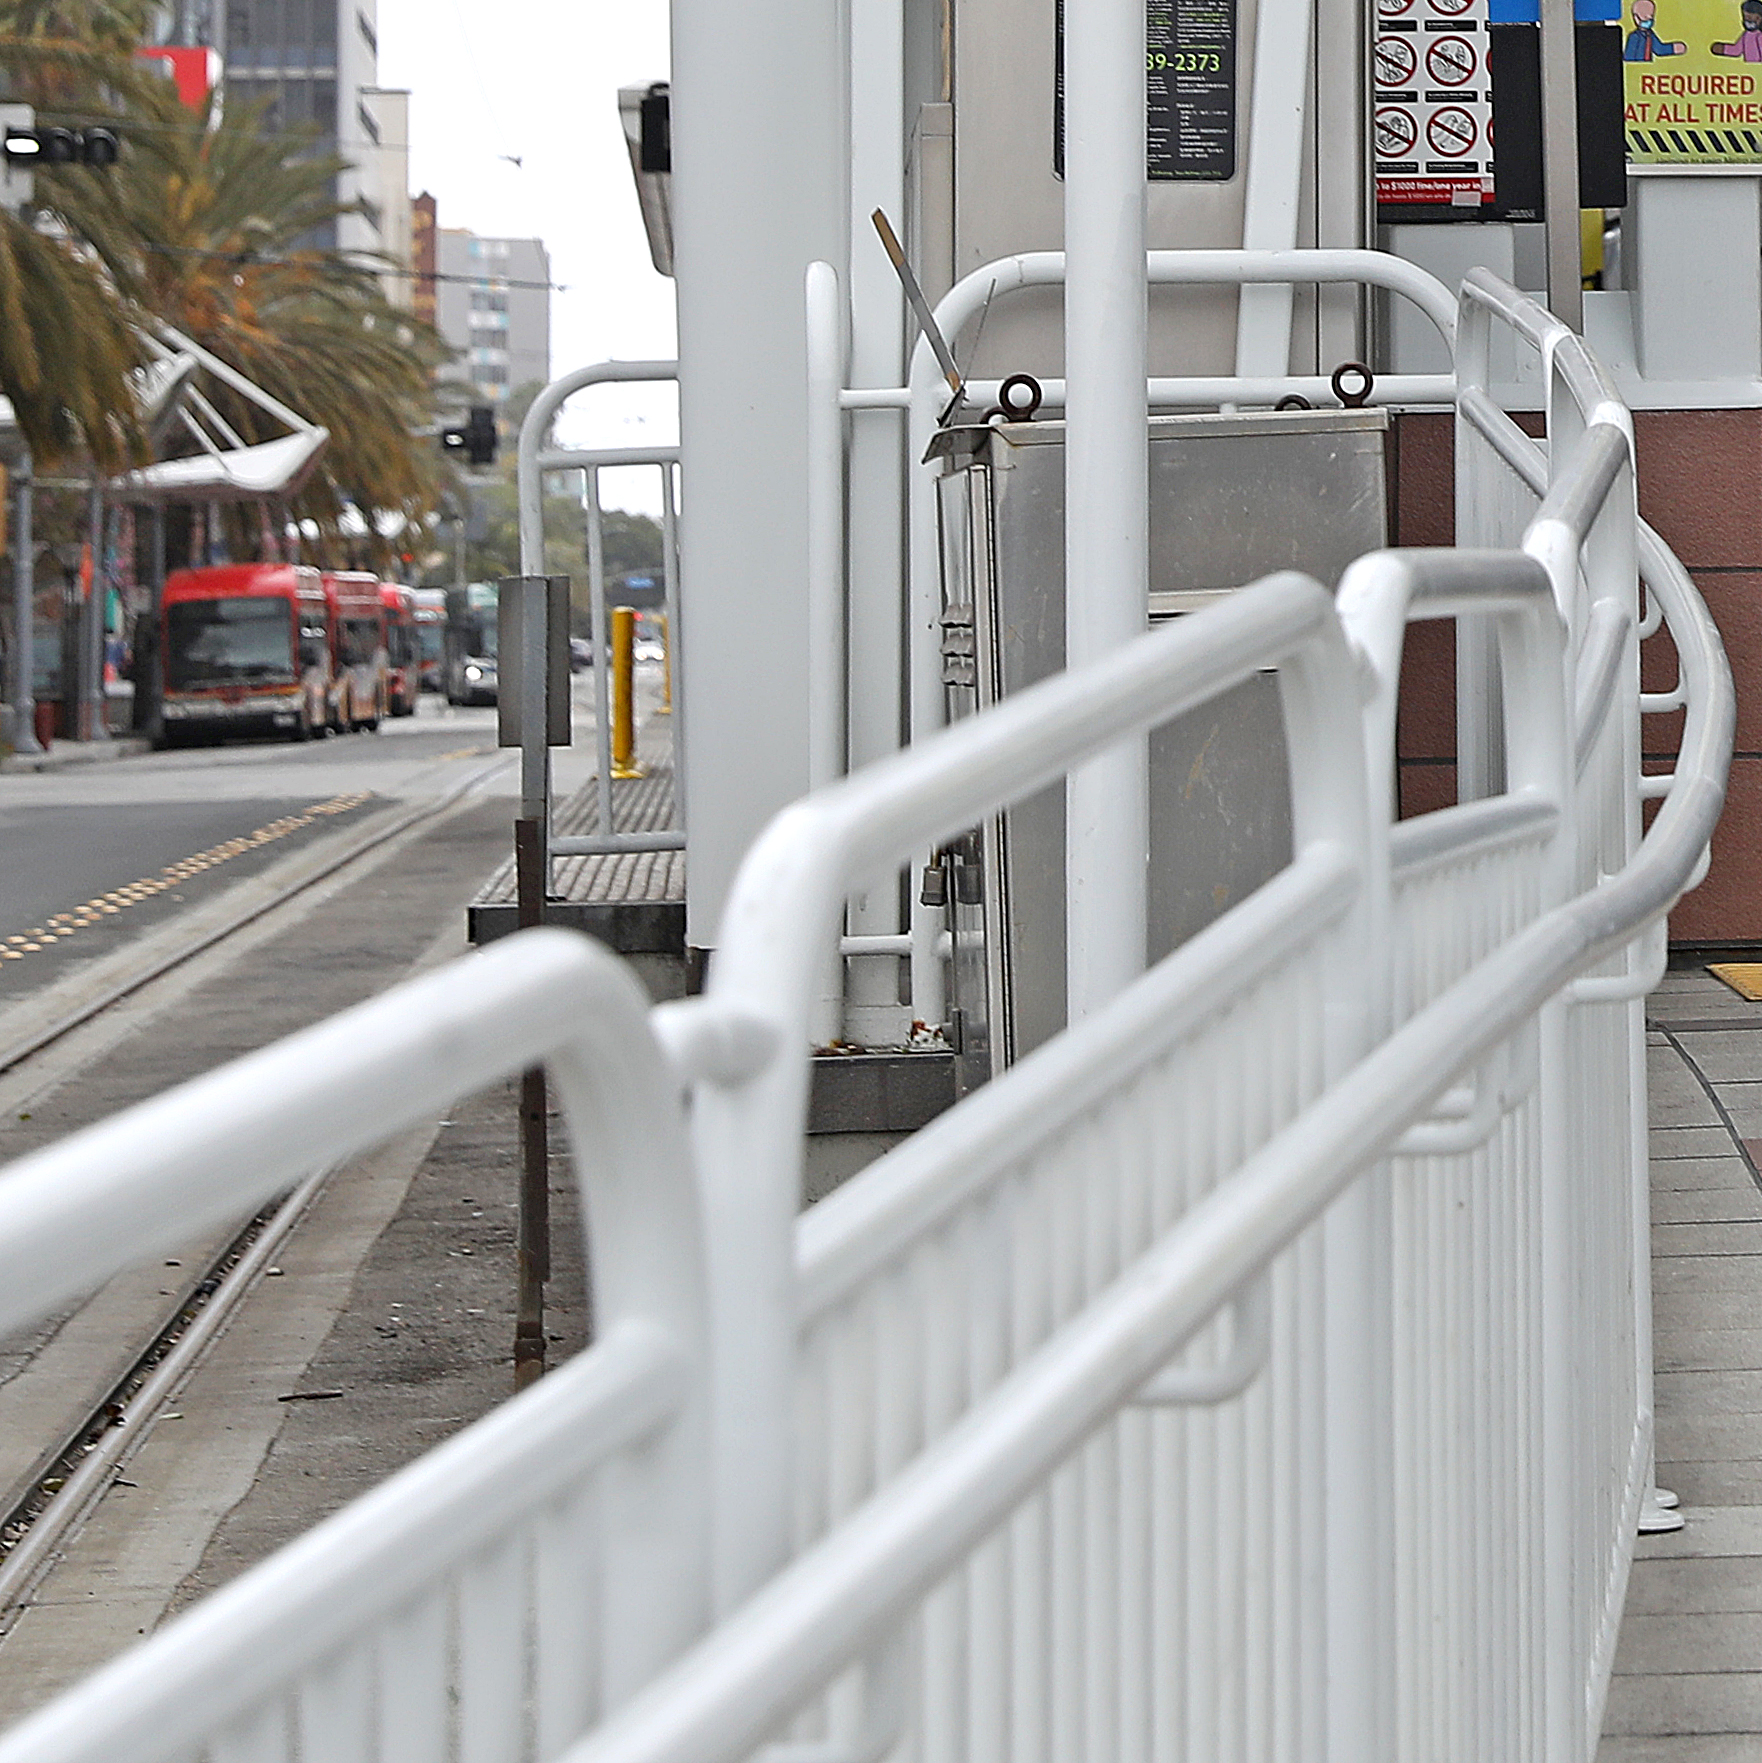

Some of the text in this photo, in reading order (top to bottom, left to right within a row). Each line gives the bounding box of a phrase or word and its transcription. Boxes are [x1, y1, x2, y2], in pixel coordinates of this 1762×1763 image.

[1641, 75, 1755, 98] REQUIRED
[1624, 103, 1651, 123] AT
[1656, 103, 1700, 123] ALL
[1391, 181, 1416, 191] $1000
